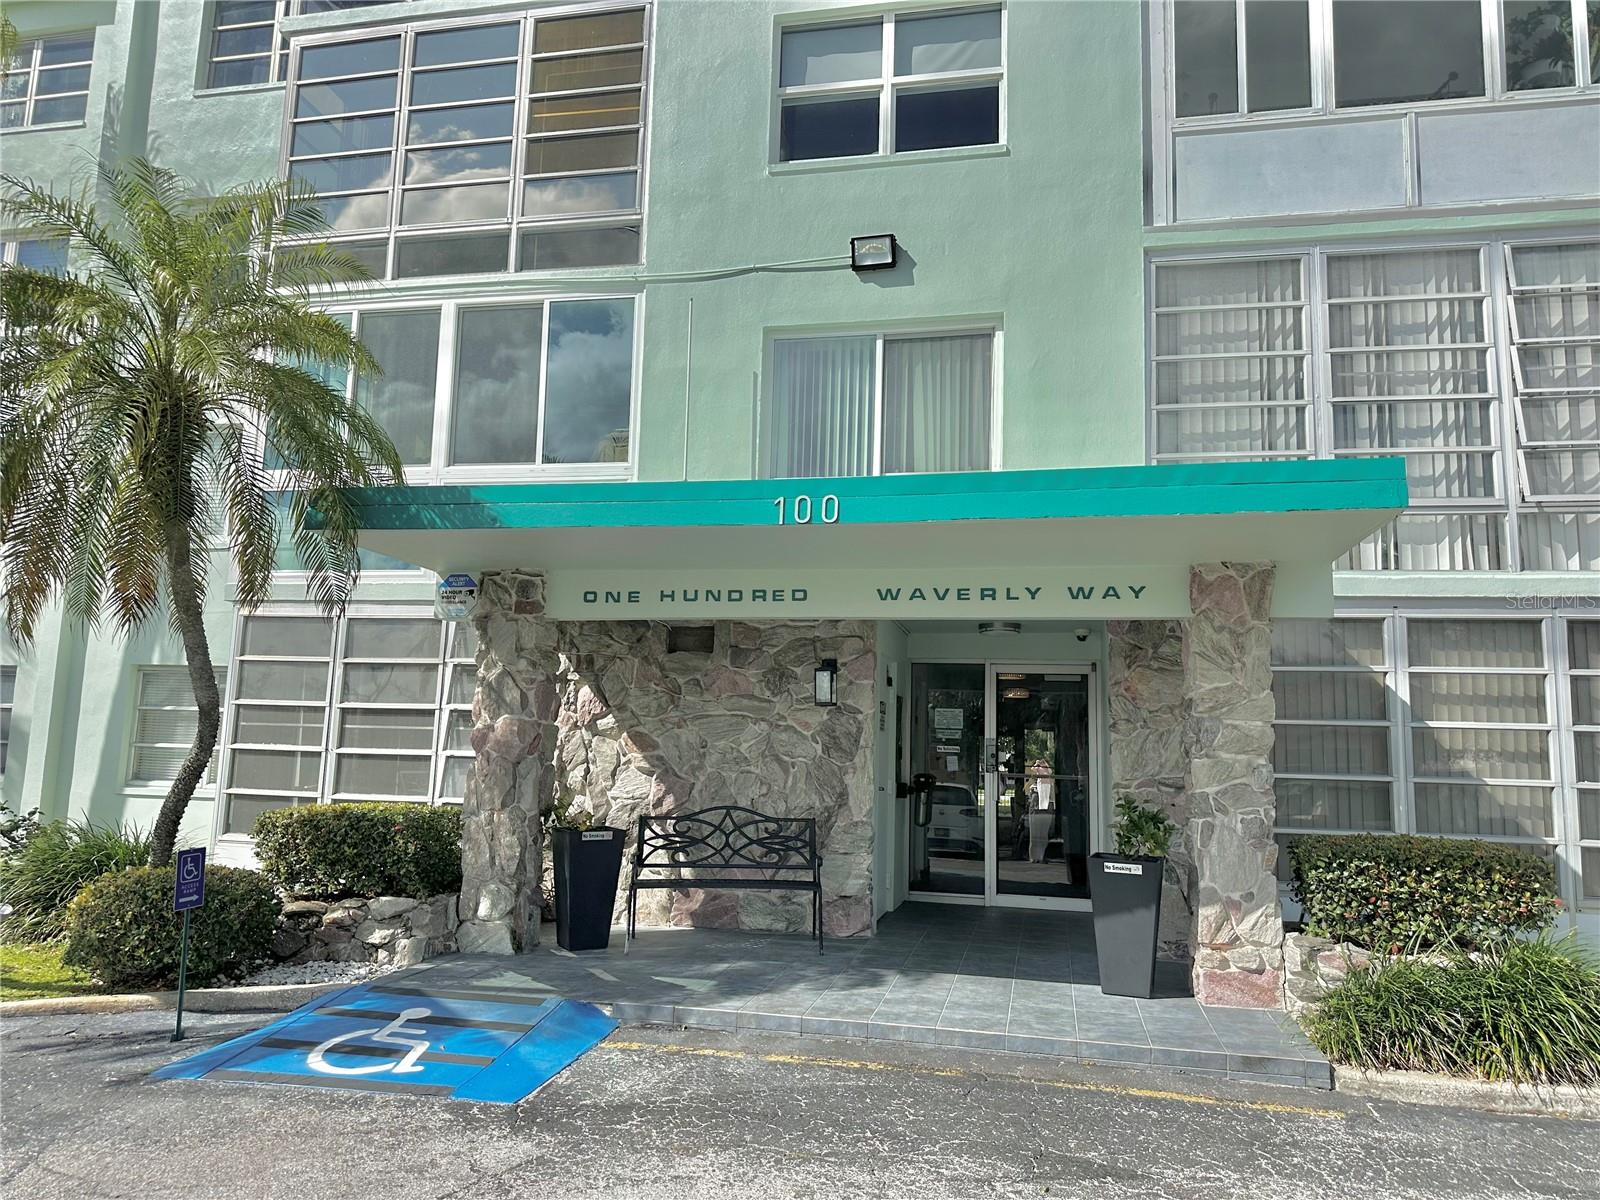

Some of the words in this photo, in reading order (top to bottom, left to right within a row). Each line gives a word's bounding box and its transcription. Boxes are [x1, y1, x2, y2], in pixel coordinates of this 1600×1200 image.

[773, 494, 839, 525] 100
[583, 590, 641, 604] ONE
[659, 588, 808, 603] HUNDRED
[875, 586, 1043, 601] WAVERLY
[1067, 585, 1147, 600] WAY
[1111, 864, 1132, 872] Smoking
